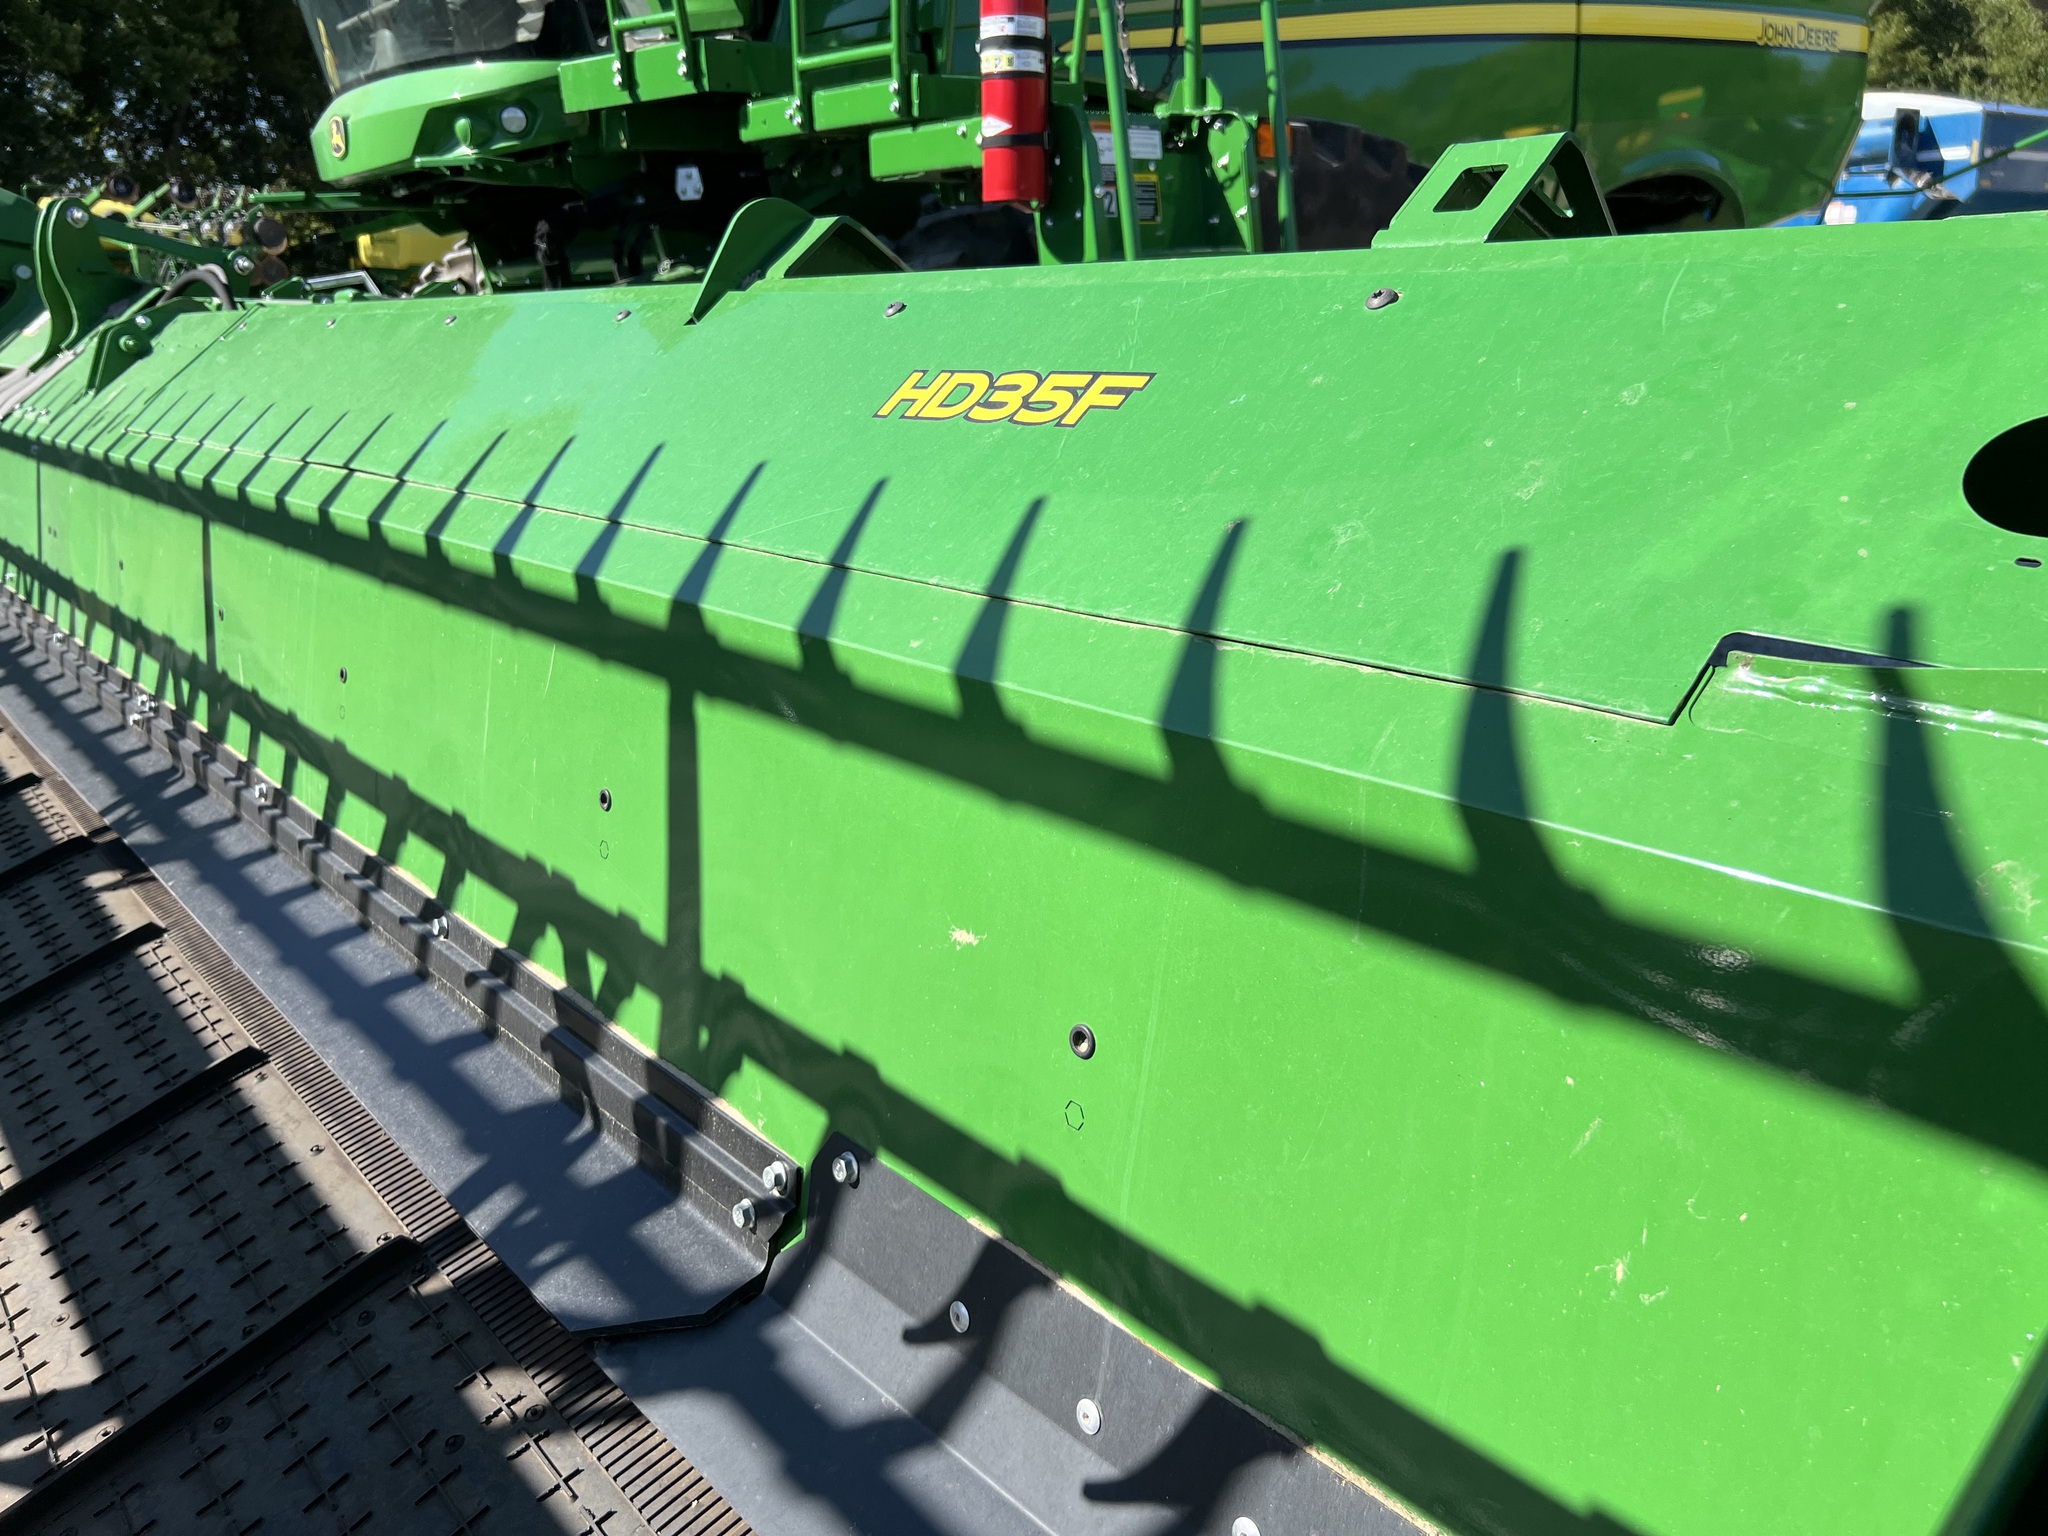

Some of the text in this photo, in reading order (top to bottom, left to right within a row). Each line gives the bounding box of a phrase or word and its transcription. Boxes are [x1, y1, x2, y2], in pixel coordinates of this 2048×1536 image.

[1756, 17, 1839, 49] JOHN DEERE
[872, 370, 1157, 428] HD35F
